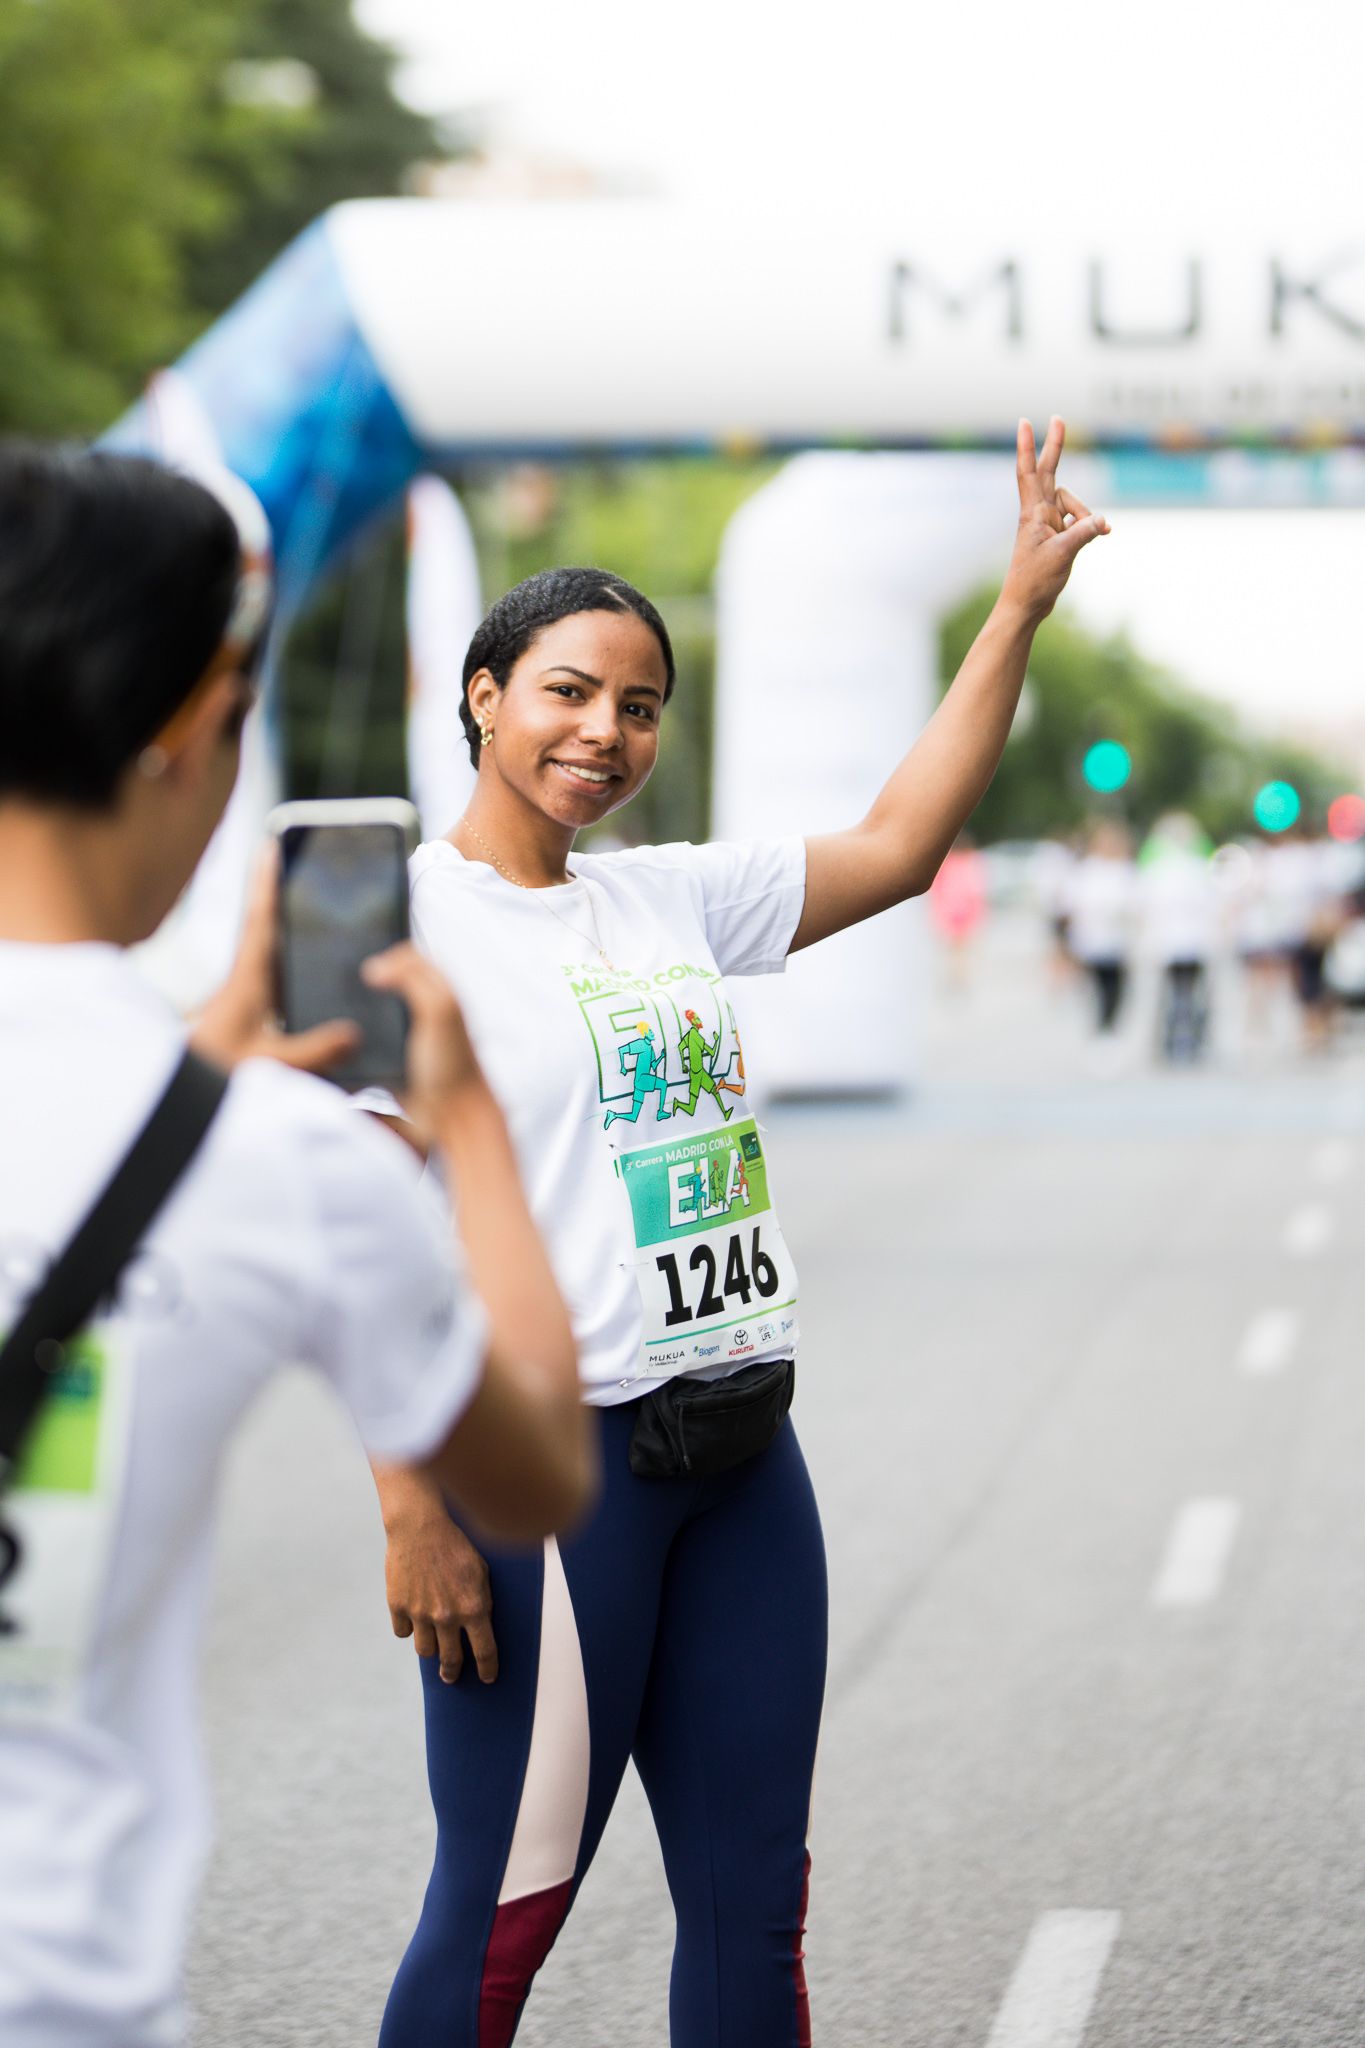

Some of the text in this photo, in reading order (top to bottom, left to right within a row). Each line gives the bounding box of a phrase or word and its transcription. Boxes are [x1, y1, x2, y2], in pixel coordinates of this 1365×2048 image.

[665, 1143, 708, 1164] MADRID
[668, 1148, 751, 1229] ELA
[656, 1226, 779, 1327] 1246
[649, 1350, 685, 1362] MUKUA
